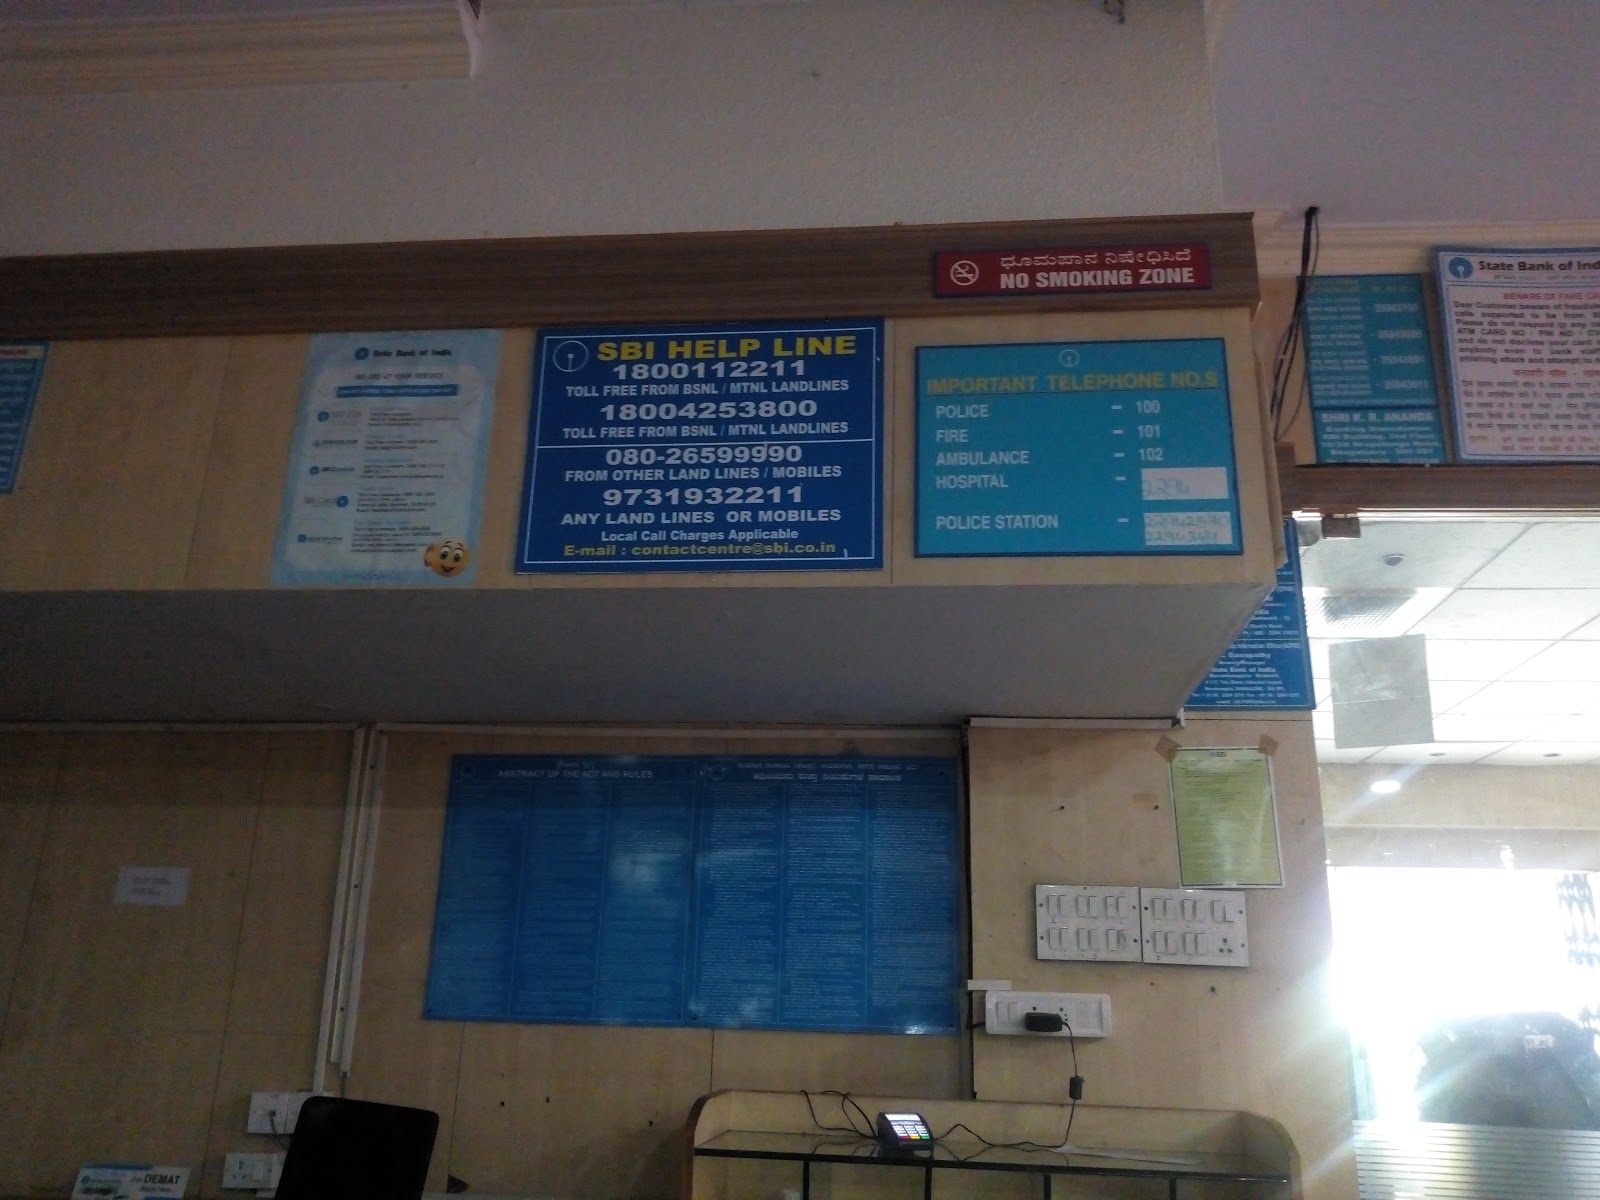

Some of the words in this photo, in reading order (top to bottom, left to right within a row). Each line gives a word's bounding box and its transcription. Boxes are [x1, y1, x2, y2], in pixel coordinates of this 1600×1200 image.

[1478, 261, 1514, 270] State
[1518, 261, 1555, 271] Bank
[1559, 261, 1572, 270] of
[1000, 273, 1029, 289] NO
[1036, 269, 1133, 287] SMOKING
[1139, 268, 1195, 284] ZONE
[598, 341, 655, 361] SBI
[669, 338, 761, 359] HELP
[774, 336, 857, 356] LINE
[612, 360, 805, 380] 1800112211
[566, 386, 599, 398] TOLL
[603, 385, 638, 397] FREE
[641, 384, 679, 396] FROM
[683, 383, 718, 395] BSNL
[730, 382, 768, 394] MTNL
[771, 380, 849, 392] LANDLINES
[927, 377, 1037, 395] IMPORTANT
[1047, 373, 1164, 392] TELEPHONE
[1171, 371, 1218, 388] NO.S
[601, 400, 818, 421] 18004253800
[936, 405, 989, 419] POLICE
[1136, 401, 1161, 414] 100
[563, 427, 596, 439] TOLL
[600, 427, 635, 438] FREE
[639, 426, 677, 438] FROM
[681, 425, 716, 436] BSNL
[729, 423, 766, 435] MTNL
[769, 422, 848, 434] LANDLINES
[936, 429, 968, 443] FIRE
[1138, 425, 1161, 439] 101
[606, 444, 802, 466] 080-26599990
[936, 450, 1029, 466] AMBULANCE
[1138, 448, 1164, 461] 102
[565, 470, 608, 482] FROM
[612, 469, 664, 481] OTHER
[668, 468, 710, 480] LAND
[714, 467, 759, 479] LINES
[772, 465, 842, 478] MOBILES
[936, 475, 1007, 490] HOSPITAL
[602, 486, 803, 506] 9731932211
[561, 512, 601, 525] ANY
[606, 512, 655, 524] LAND
[661, 511, 715, 523] LINES
[726, 510, 752, 522] OR
[759, 509, 841, 522] MOBILES
[936, 515, 991, 529] POLICE
[995, 514, 1058, 529] STATION
[601, 531, 638, 542] Local
[641, 530, 666, 541] Call
[670, 529, 725, 542] Charges
[729, 528, 799, 541] Applicable
[564, 544, 616, 556] E-mail
[631, 542, 836, 556] contactcentre@sbi.co.in
[623, 770, 652, 778] RULES
[144, 1174, 180, 1184] DEMAT
